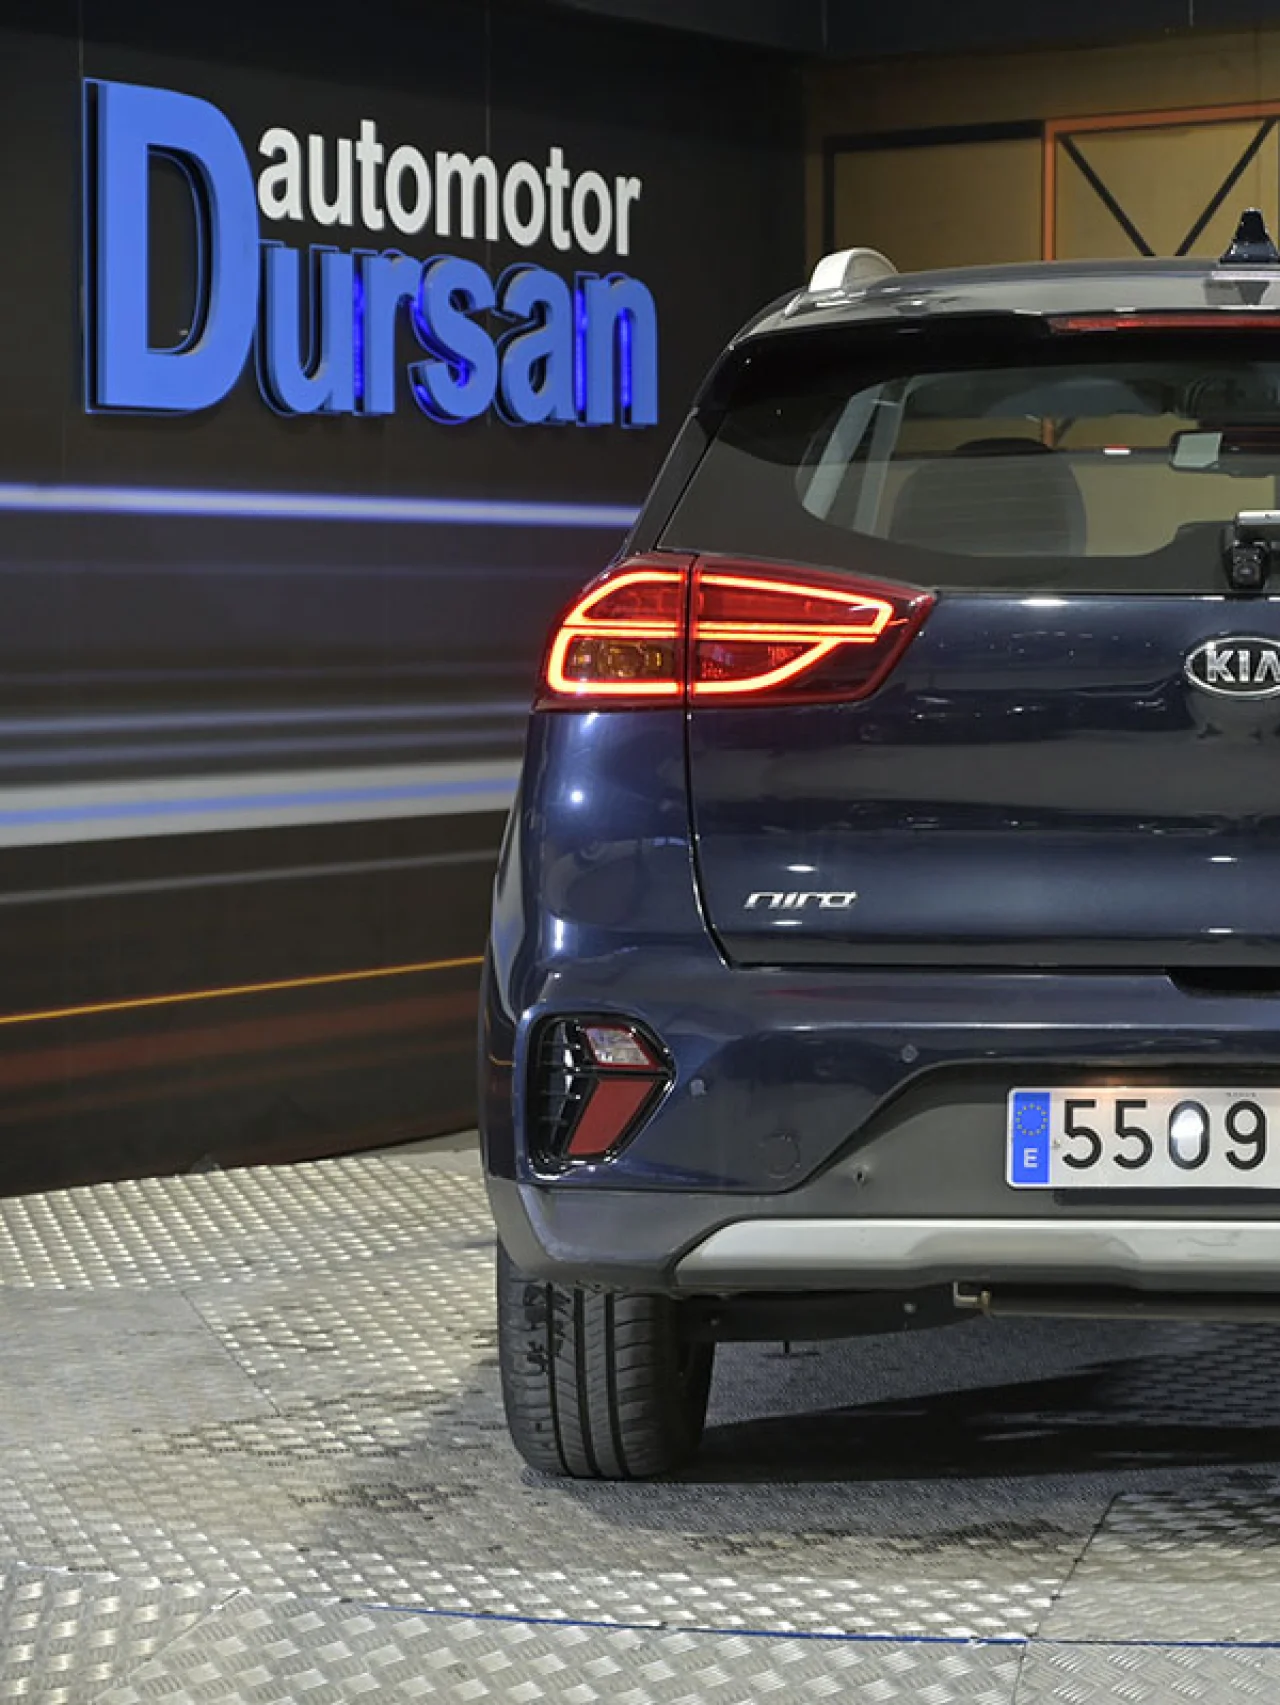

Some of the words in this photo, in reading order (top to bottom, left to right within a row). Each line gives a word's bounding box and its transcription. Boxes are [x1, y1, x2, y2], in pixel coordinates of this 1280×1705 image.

[258, 119, 642, 256] automotor
[83, 77, 658, 427] Dursan
[1023, 1148, 1038, 1168] E
[1062, 1099, 1267, 1170] 5509
